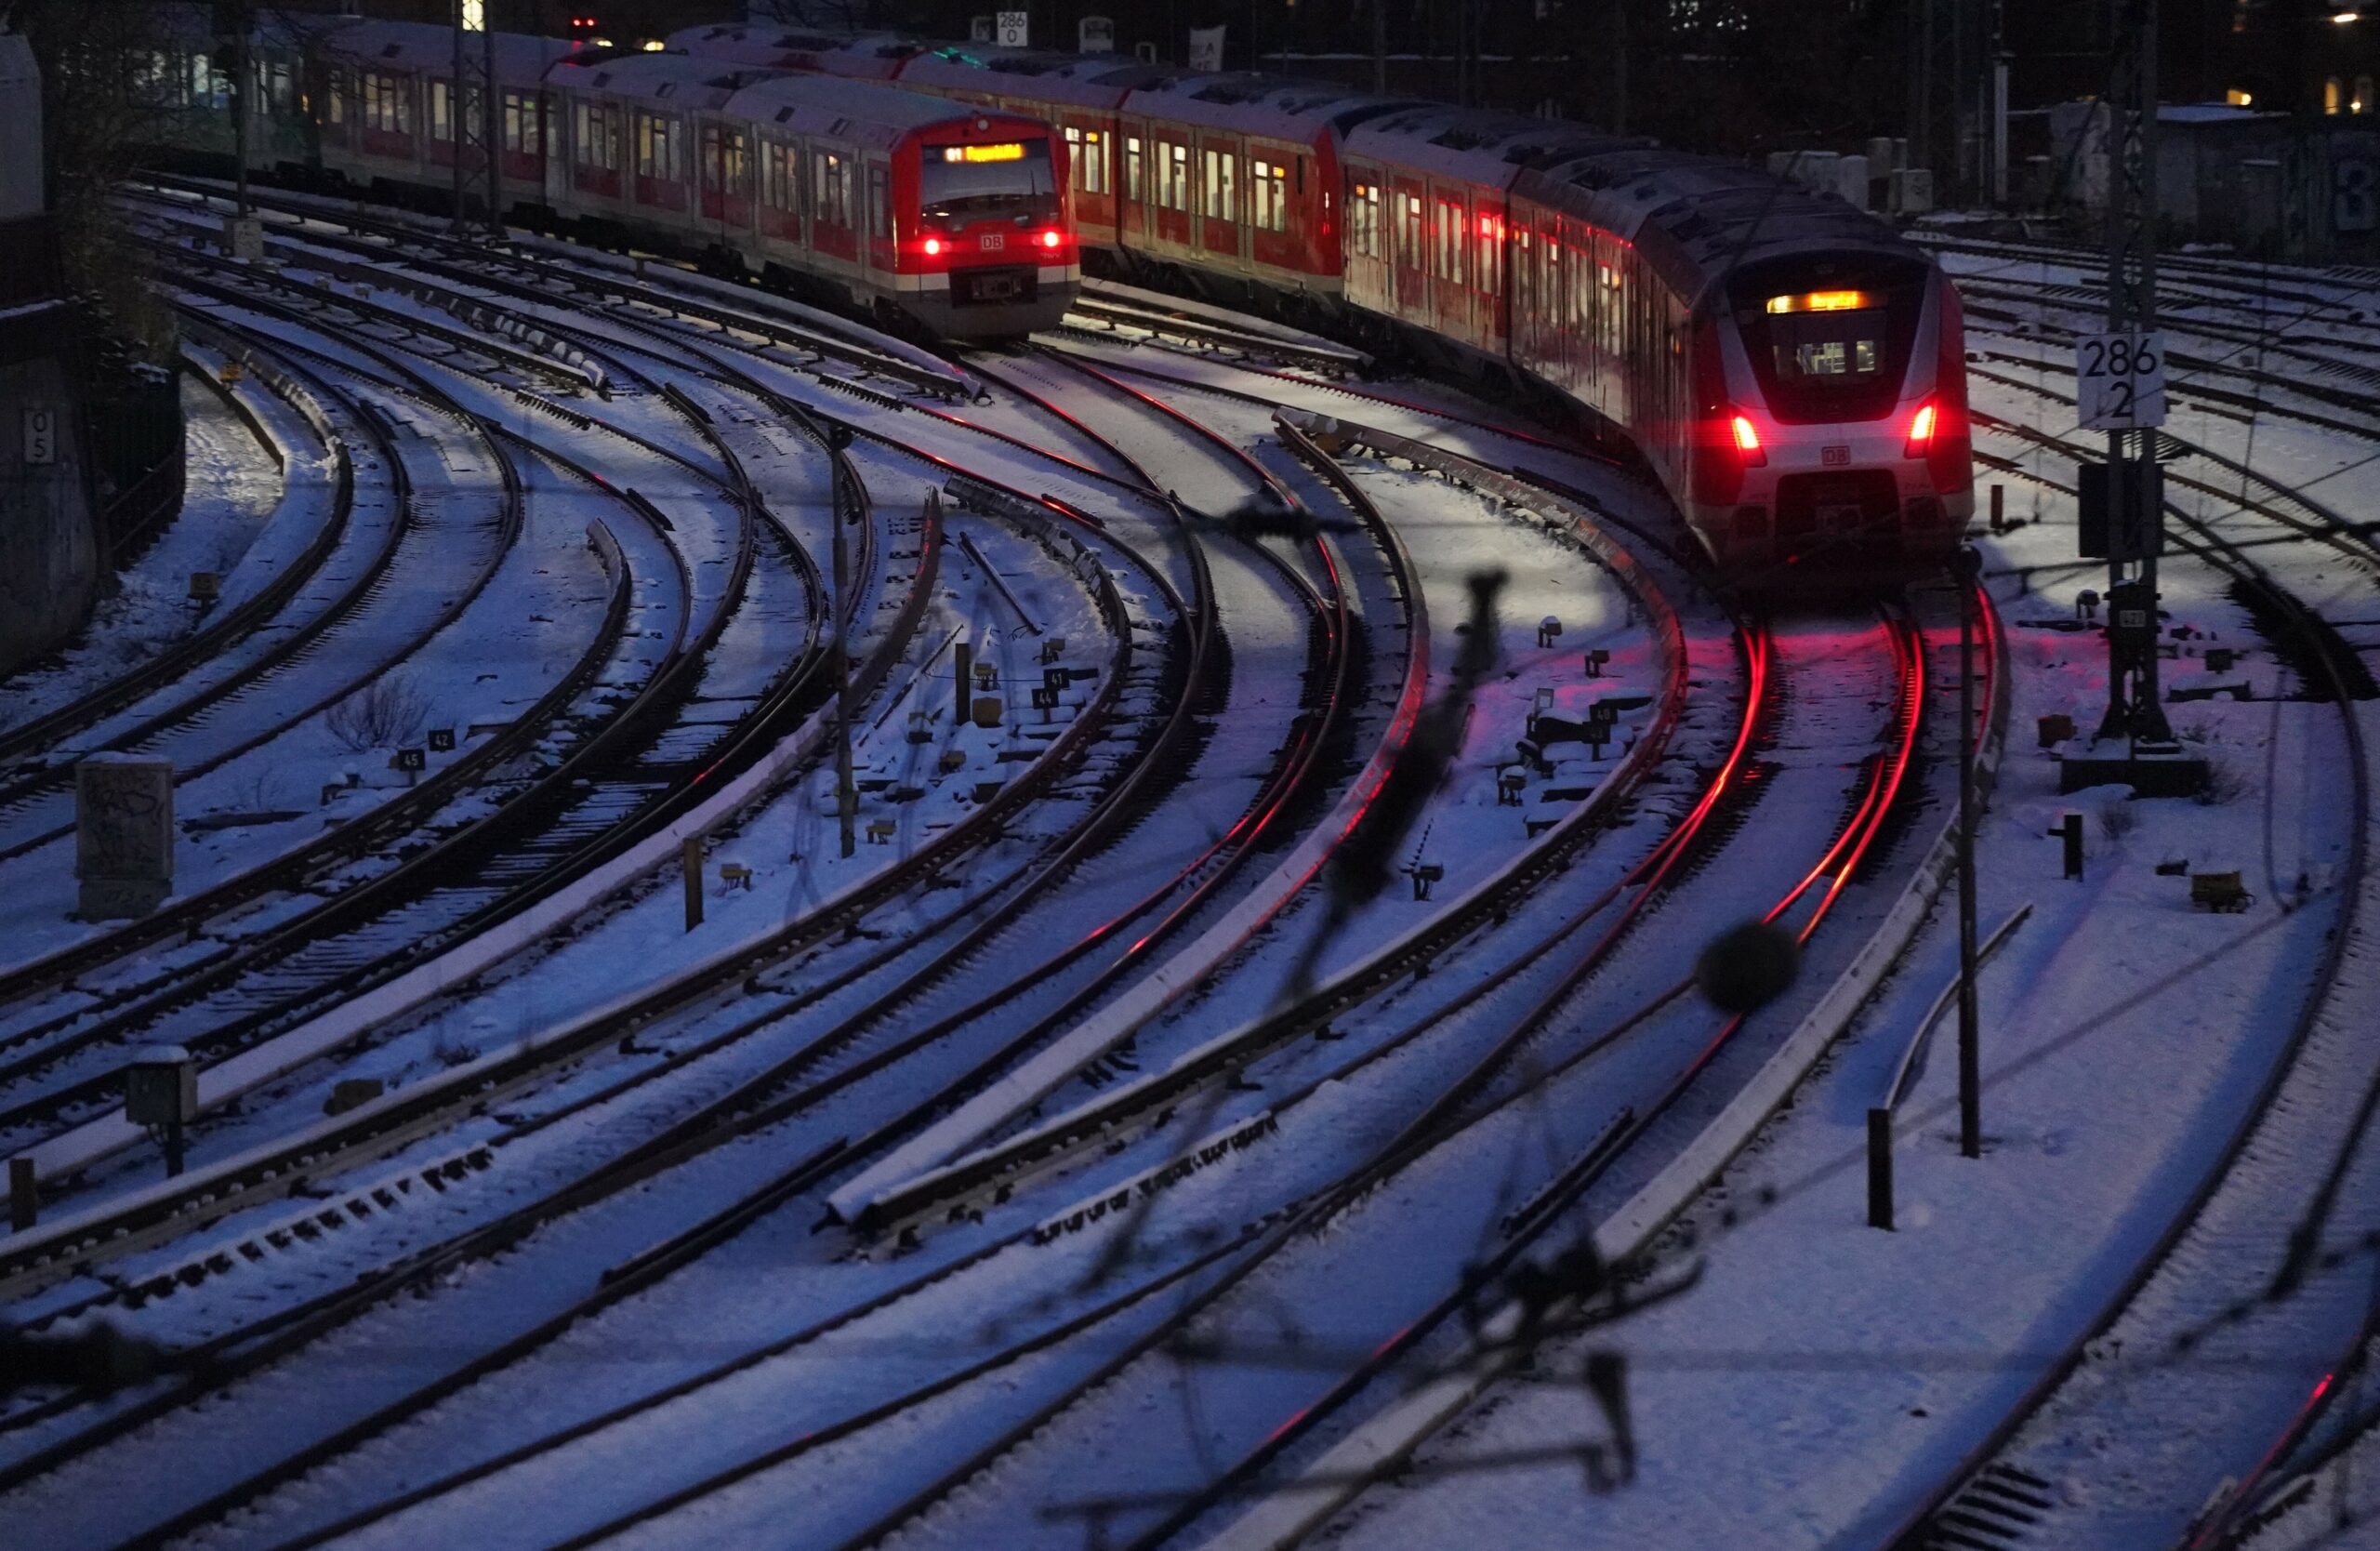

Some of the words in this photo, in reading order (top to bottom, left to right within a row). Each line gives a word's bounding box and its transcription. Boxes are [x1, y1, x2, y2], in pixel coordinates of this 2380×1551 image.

[999, 13, 1025, 28] 286
[1007, 30, 1017, 43] 0
[983, 236, 1002, 249] DB
[2083, 338, 2156, 378] 286
[2109, 381, 2133, 418] 2
[1825, 449, 1846, 462] DB
[1051, 672, 1063, 685] 41
[1039, 693, 1051, 705] 44
[435, 734, 448, 746] 42
[404, 753, 418, 766] 45
